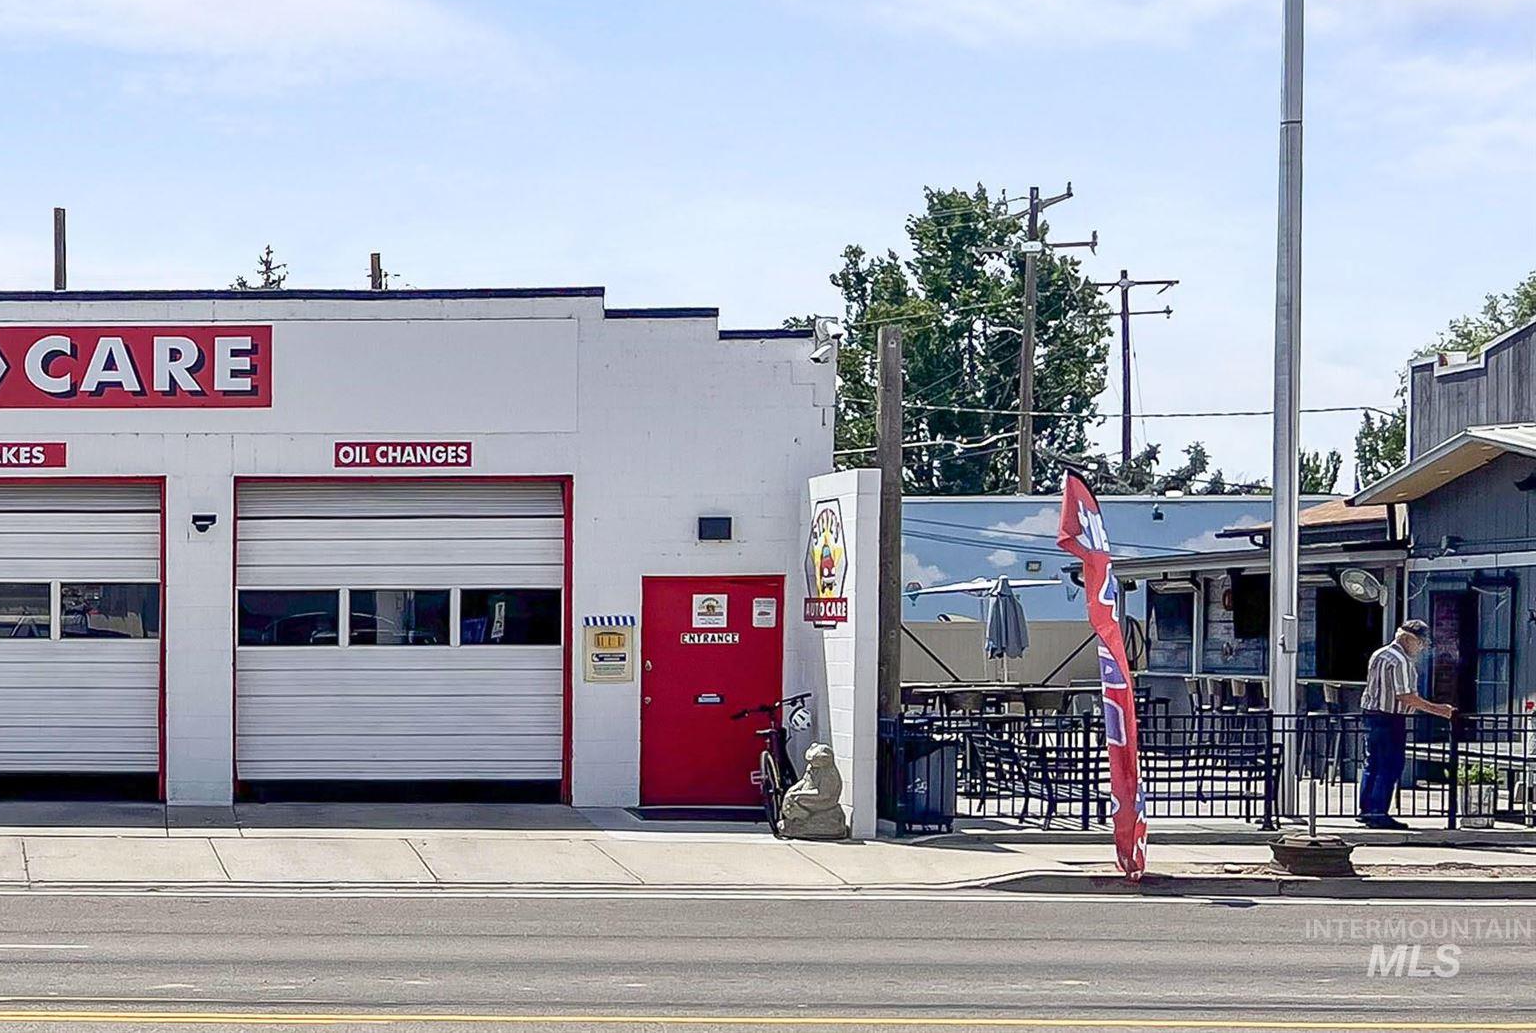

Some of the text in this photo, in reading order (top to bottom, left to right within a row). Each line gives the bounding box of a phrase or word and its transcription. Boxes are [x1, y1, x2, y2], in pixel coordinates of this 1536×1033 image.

[24, 335, 259, 398] CARE
[338, 446, 468, 464] OIL CHANGES
[805, 600, 847, 618] AUTO CARE
[681, 633, 738, 643] ENTRANCE
